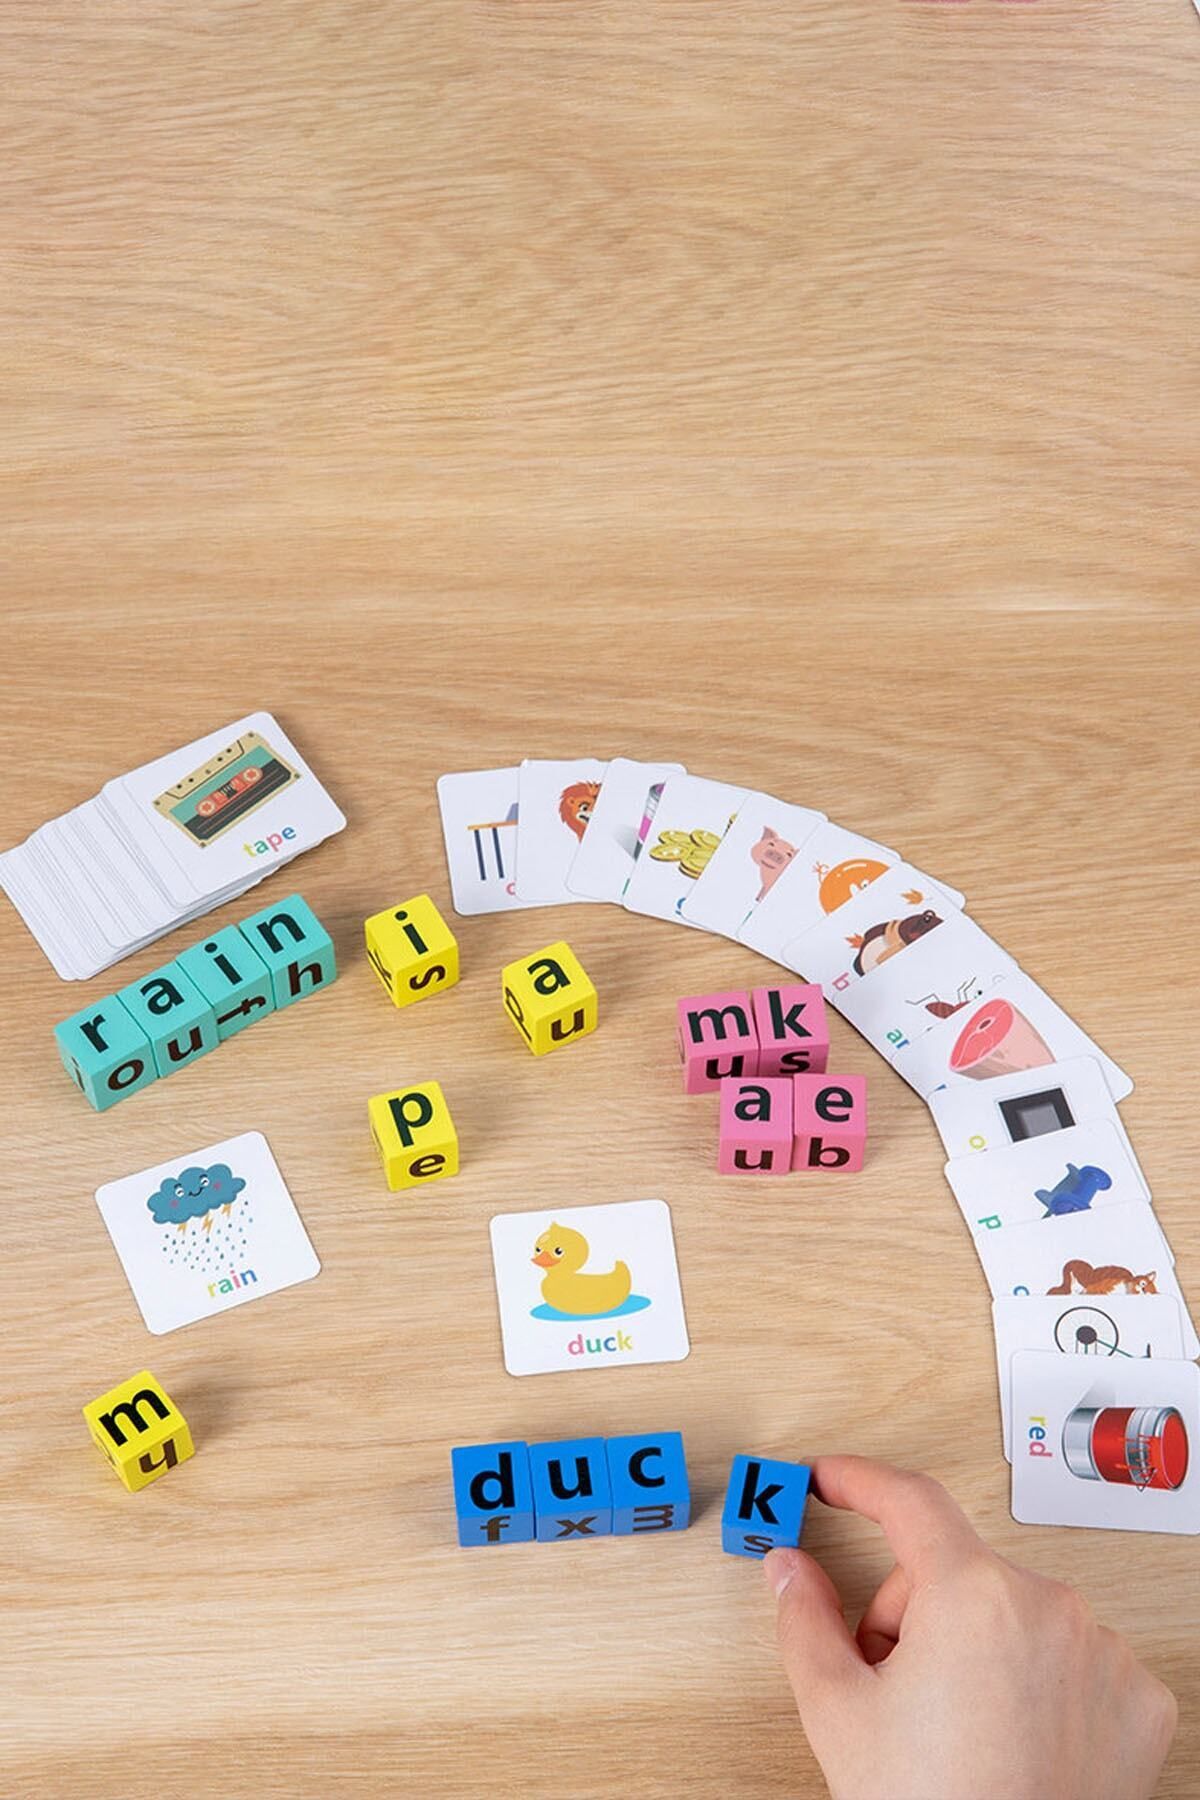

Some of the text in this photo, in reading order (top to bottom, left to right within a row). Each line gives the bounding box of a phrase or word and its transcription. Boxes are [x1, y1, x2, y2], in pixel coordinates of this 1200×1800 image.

[243, 826, 297, 858] tape
[396, 910, 429, 955] i
[527, 958, 571, 995] a
[388, 1092, 433, 1148] p
[409, 1154, 446, 1177] e
[207, 1268, 258, 1298] rain
[567, 1330, 632, 1356] duck
[98, 1389, 171, 1447] m
[1028, 1416, 1053, 1457] red
